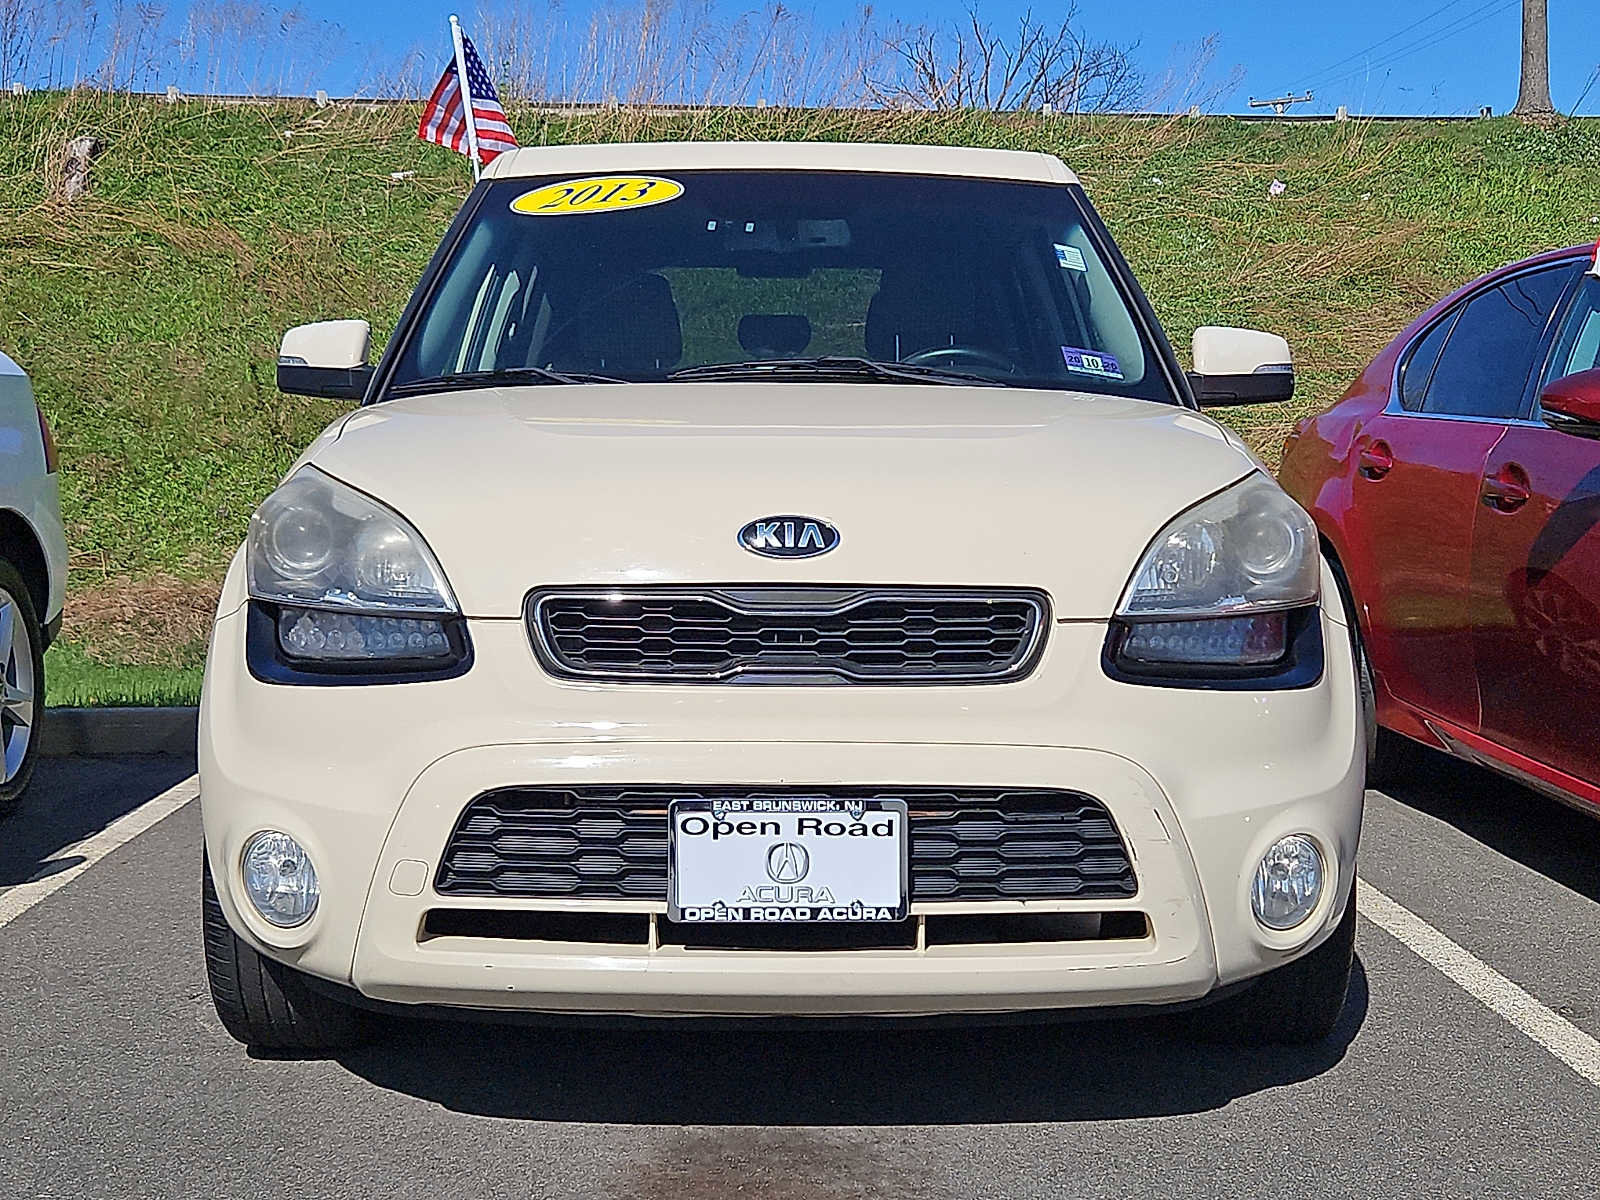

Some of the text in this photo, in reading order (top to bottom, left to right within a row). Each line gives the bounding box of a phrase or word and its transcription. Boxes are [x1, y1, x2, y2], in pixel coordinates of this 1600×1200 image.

[538, 181, 657, 210] 2013
[1085, 357, 1099, 369] 10
[755, 522, 826, 548] KIA
[713, 801, 863, 812] EAST BRUNSWICK, NJ
[680, 817, 894, 840] Open Road
[736, 886, 835, 904] ACURA
[685, 907, 893, 920] OPEN ROAD ACURA
